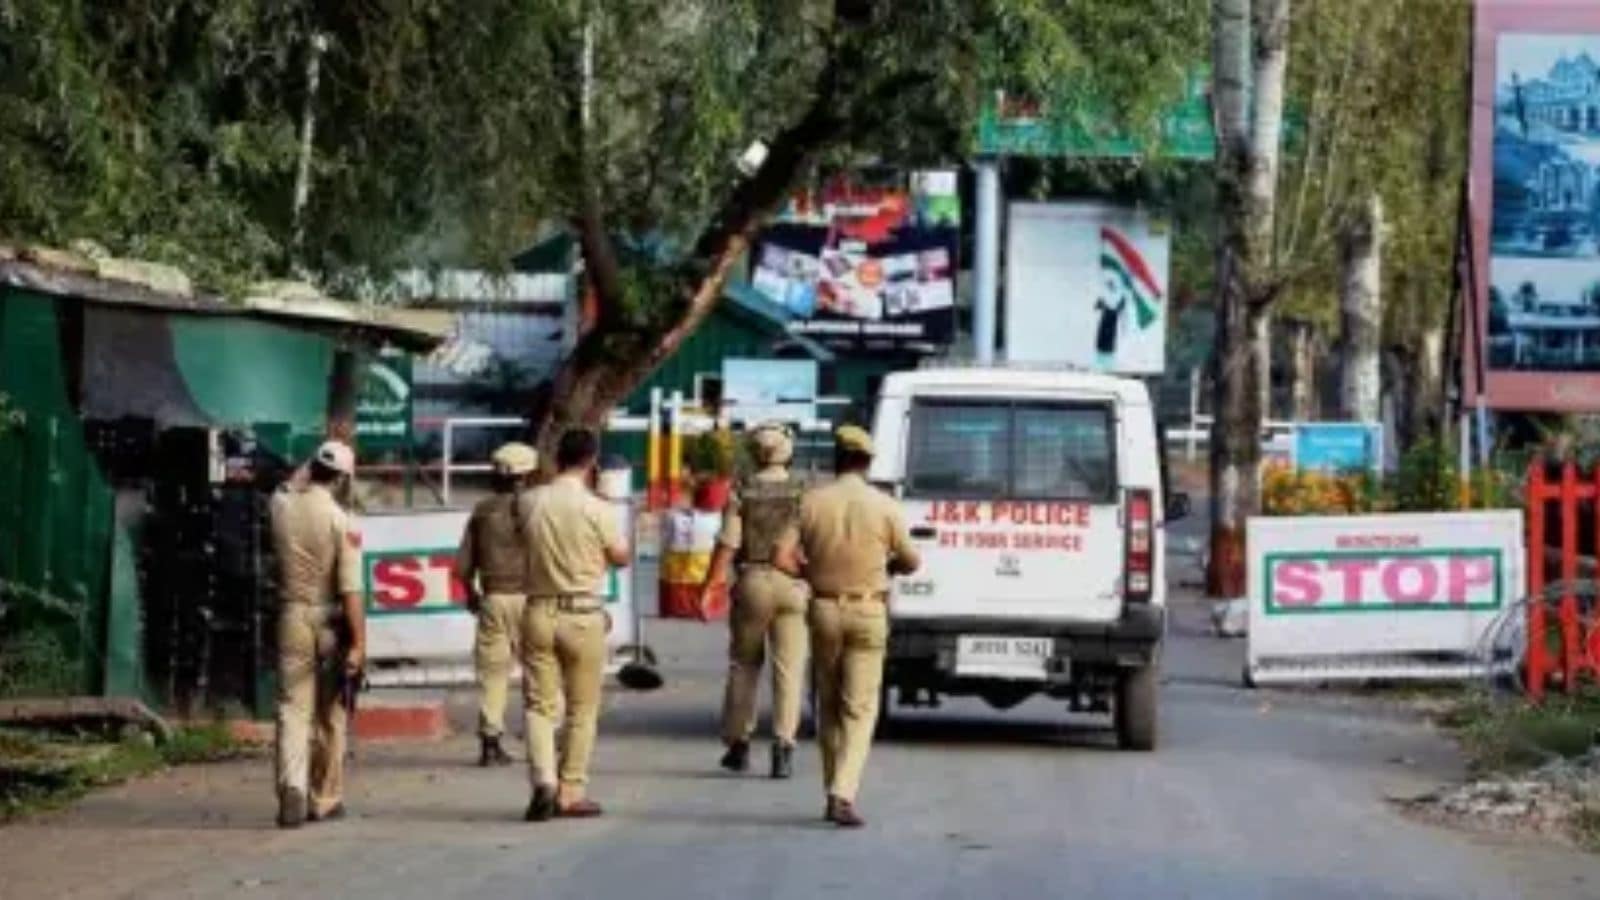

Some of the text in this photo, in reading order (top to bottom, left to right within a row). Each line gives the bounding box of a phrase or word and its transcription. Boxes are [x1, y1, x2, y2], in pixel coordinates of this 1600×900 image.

[925, 499, 1091, 527] J&K POLICE
[1013, 533, 1084, 551] SERVICE
[1275, 556, 1494, 610] STOP
